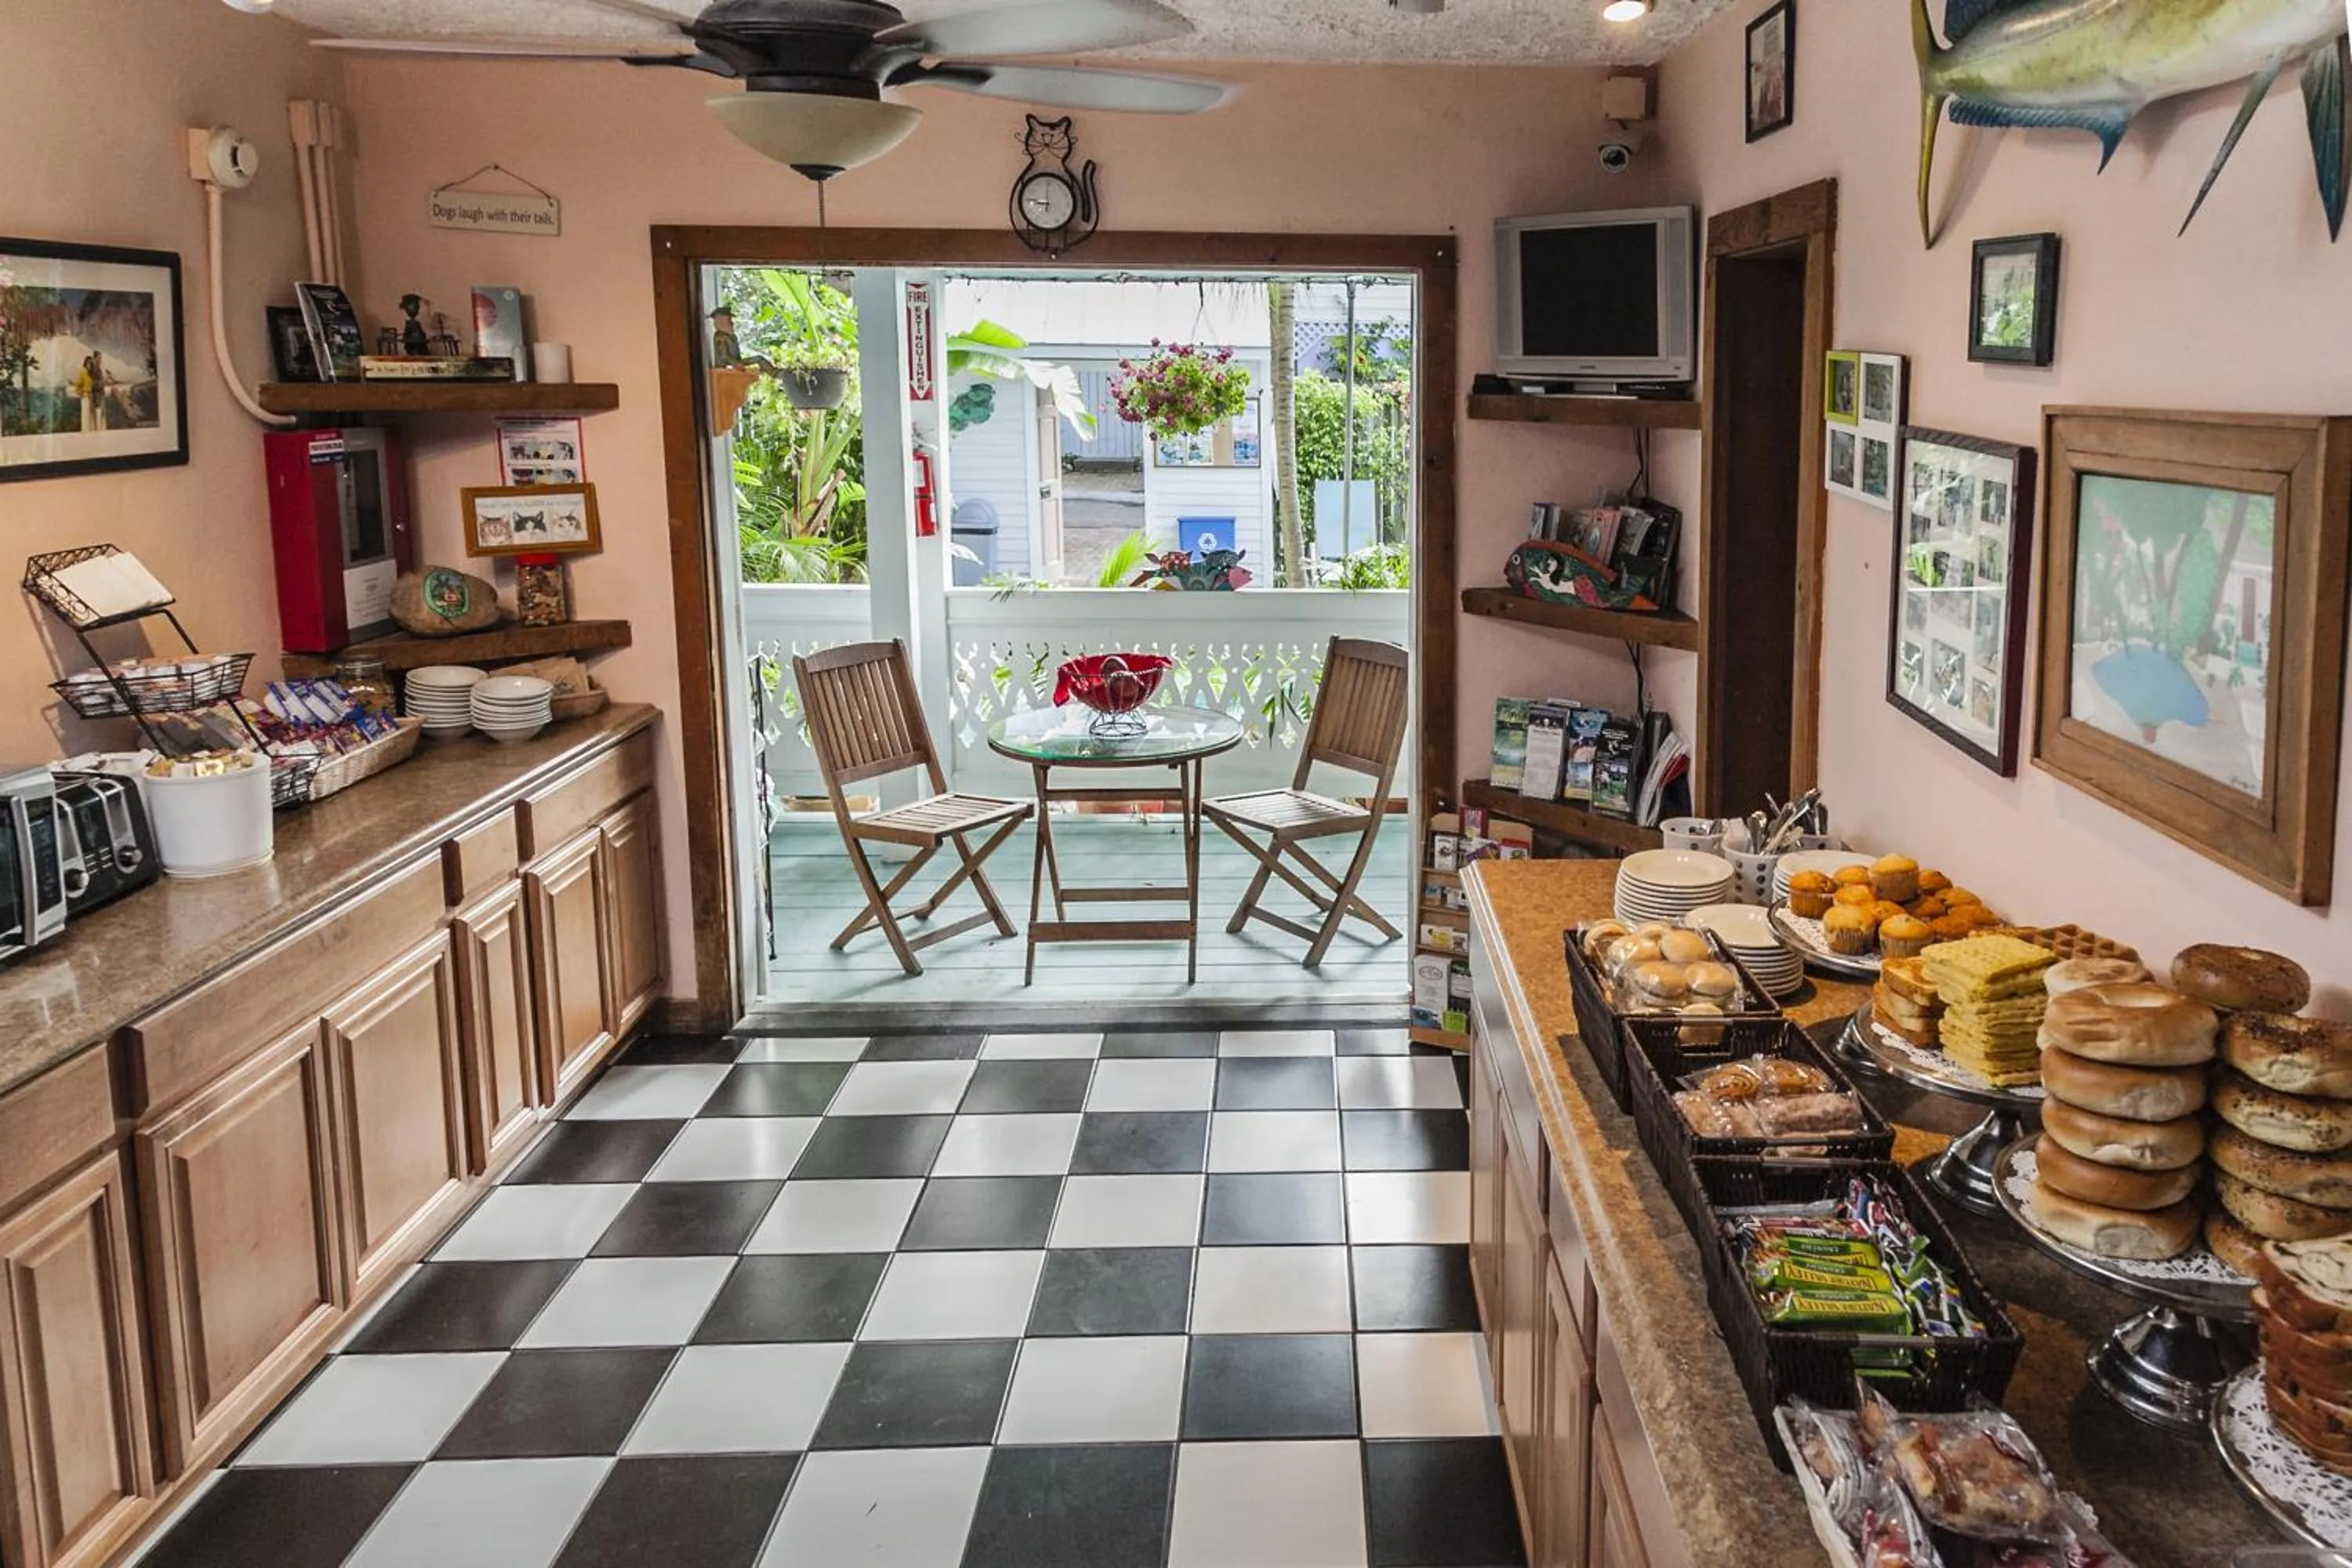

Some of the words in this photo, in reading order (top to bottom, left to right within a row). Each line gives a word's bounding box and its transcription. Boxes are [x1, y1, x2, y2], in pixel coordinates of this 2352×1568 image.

[432, 203, 456, 221] Dogs
[459, 205, 484, 223] laugh
[486, 209, 508, 222] with
[510, 210, 532, 223] their
[909, 291, 927, 303] FIRE
[915, 307, 924, 390] EXTINGUISHER
